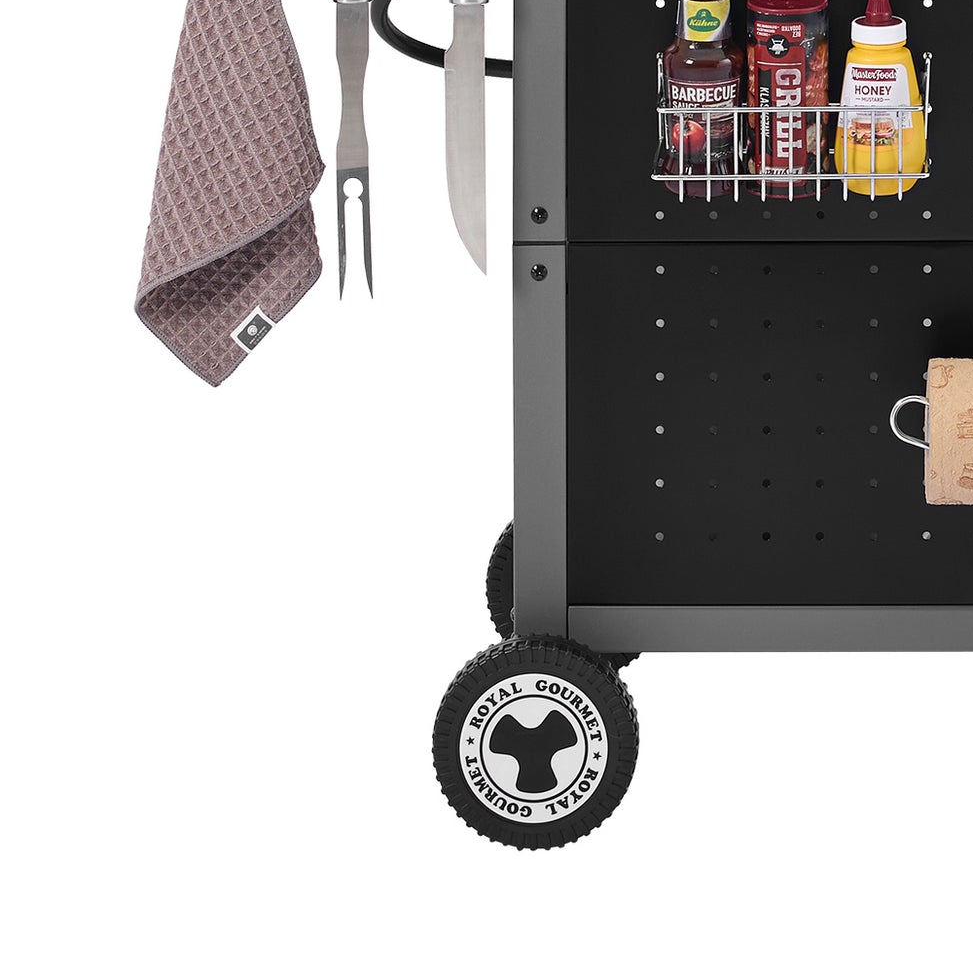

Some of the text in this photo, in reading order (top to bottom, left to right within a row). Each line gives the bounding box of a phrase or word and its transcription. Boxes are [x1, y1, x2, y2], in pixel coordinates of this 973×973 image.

[672, 84, 736, 102] BARBECUE
[775, 68, 802, 158] GRILL
[854, 85, 892, 95] HONEY
[470, 680, 602, 742] ROYAL GOURMET
[465, 756, 599, 817] ROYAL GOURMET
